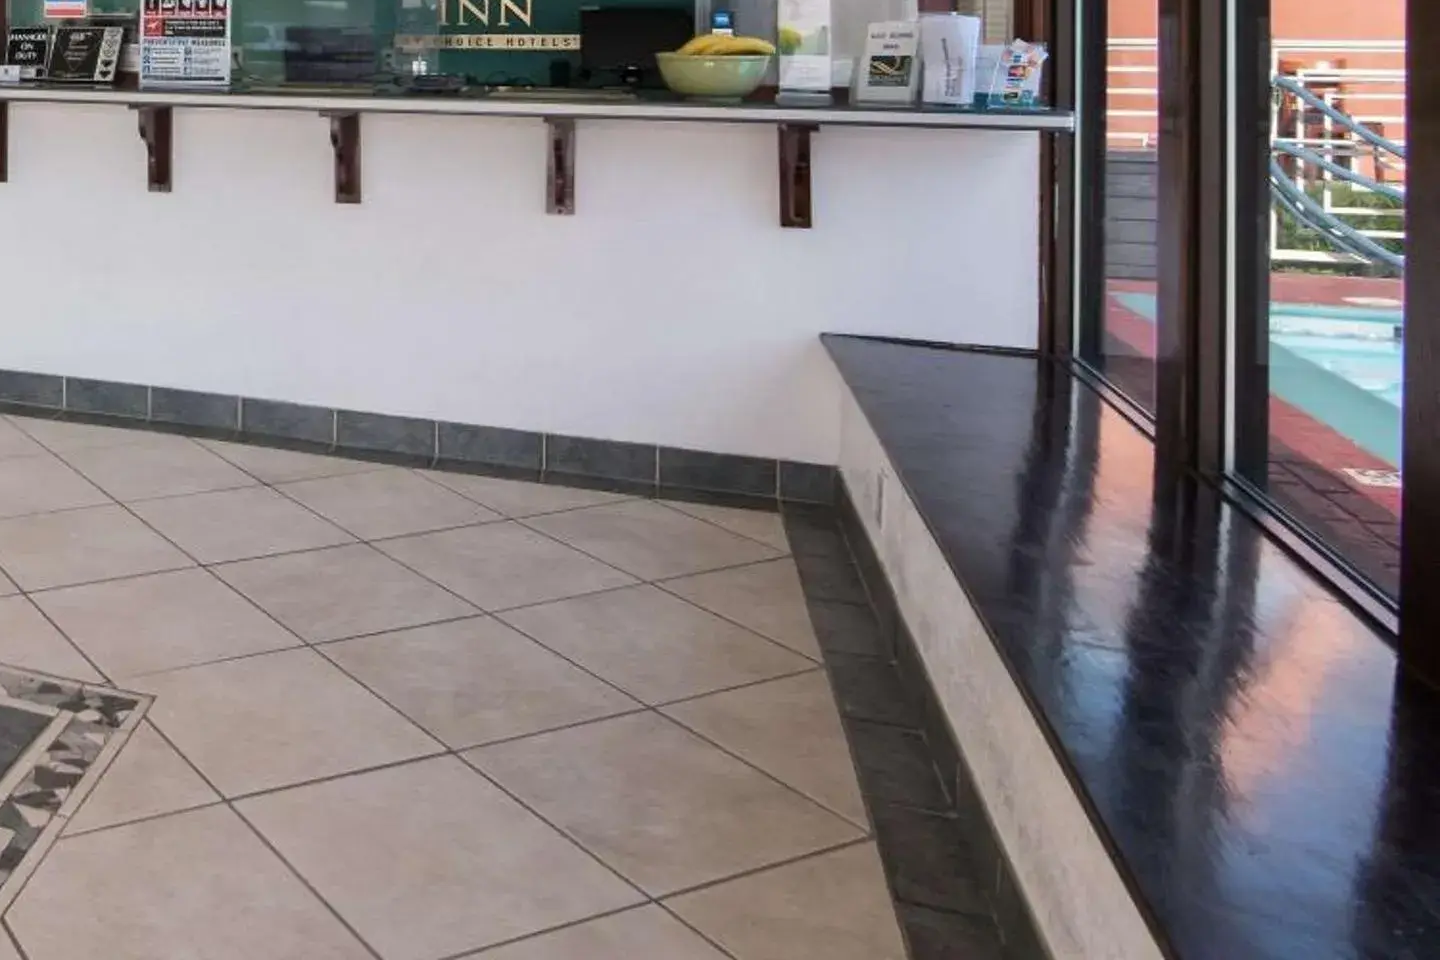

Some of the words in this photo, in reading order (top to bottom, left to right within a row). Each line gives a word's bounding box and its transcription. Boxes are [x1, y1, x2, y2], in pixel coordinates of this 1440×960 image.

[20, 41, 34, 51] ON
[506, 37, 572, 47] HOTELS
[14, 50, 37, 60] DUTY
